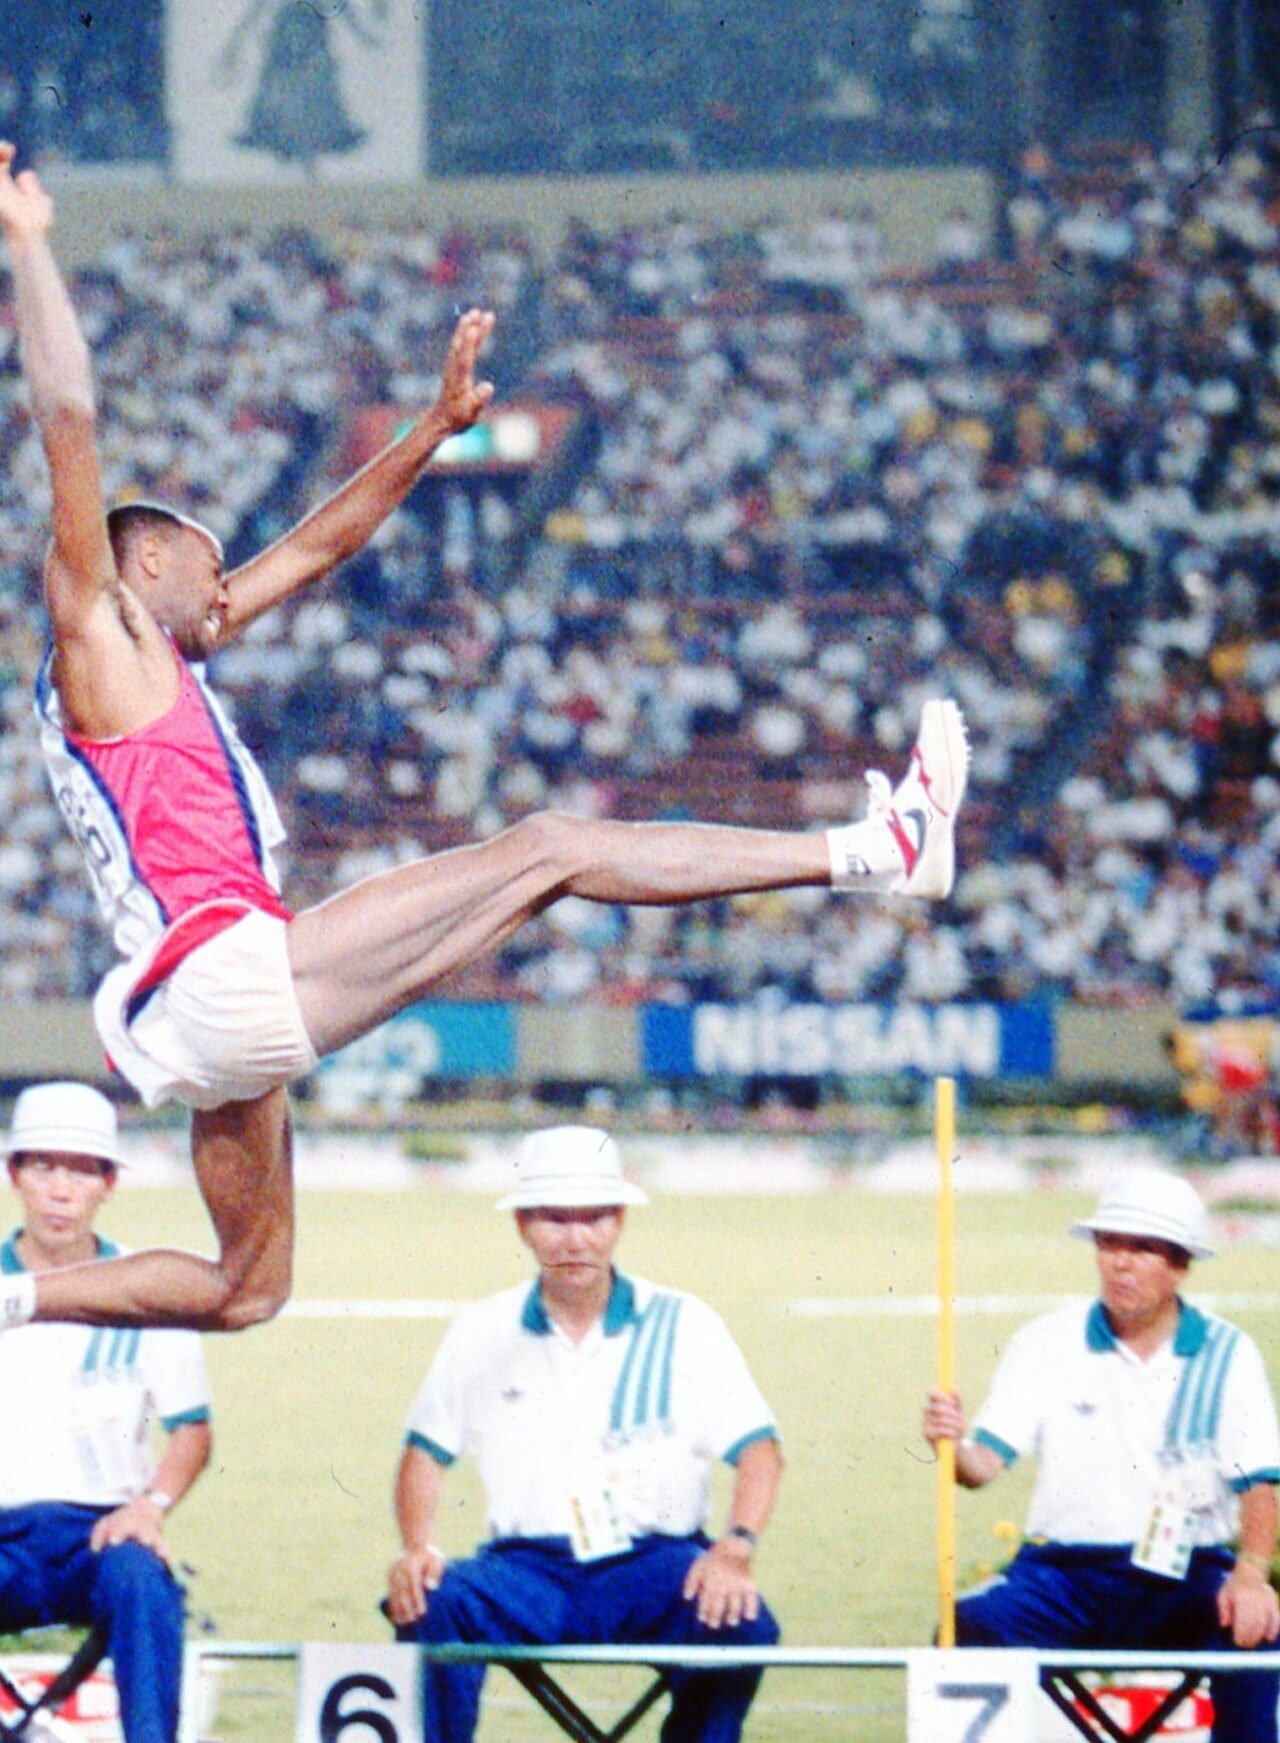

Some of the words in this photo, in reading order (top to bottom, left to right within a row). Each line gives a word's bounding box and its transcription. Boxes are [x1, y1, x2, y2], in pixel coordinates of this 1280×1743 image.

[693, 1001, 1000, 1075] NISSAN
[320, 1672, 399, 1743] 6
[936, 1683, 1011, 1743] 7
